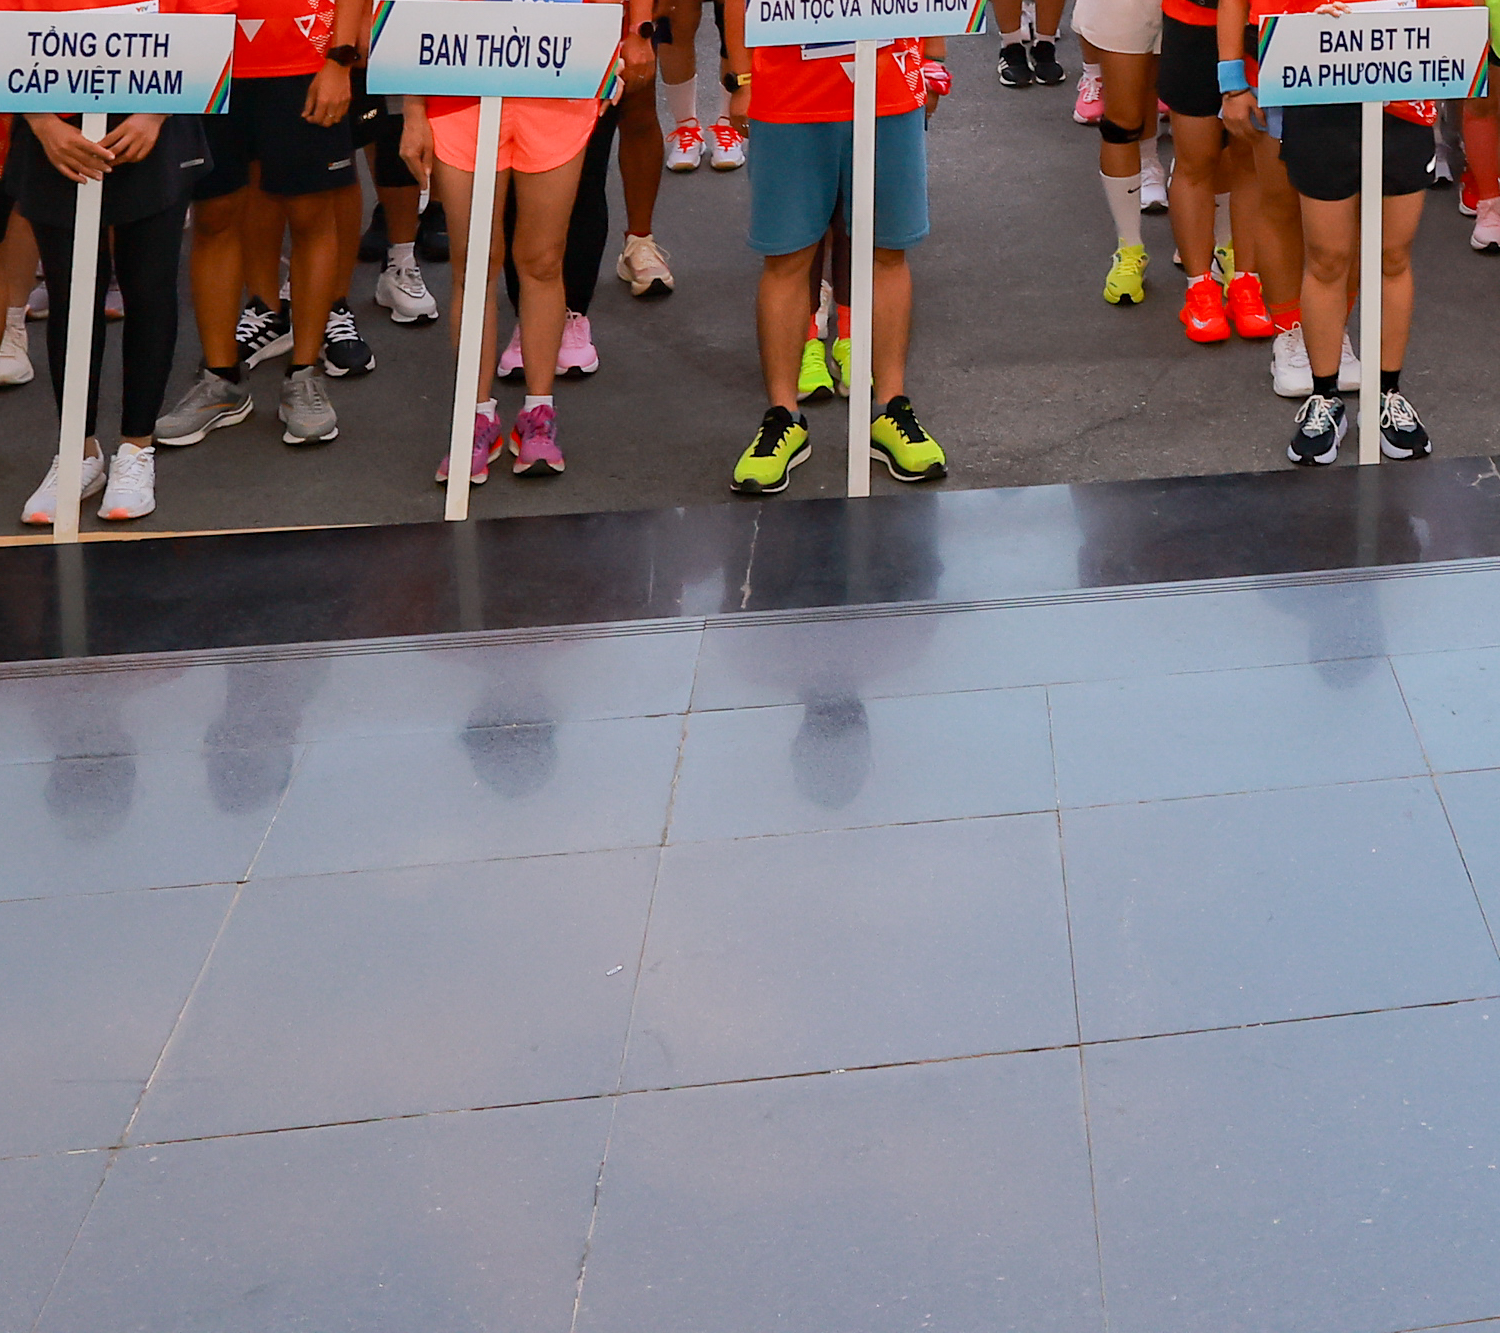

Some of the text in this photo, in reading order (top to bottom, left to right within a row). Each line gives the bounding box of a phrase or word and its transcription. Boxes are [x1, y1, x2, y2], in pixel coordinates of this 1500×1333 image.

[28, 25, 170, 58] TỔNG CTTH
[419, 26, 572, 77] BAN THỜI SỰ
[1320, 27, 1430, 53] BAN BT TH
[8, 63, 183, 100] CÁP VIỆT NAM
[1282, 55, 1465, 88] ĐA PHƯƠNG TIỆN
